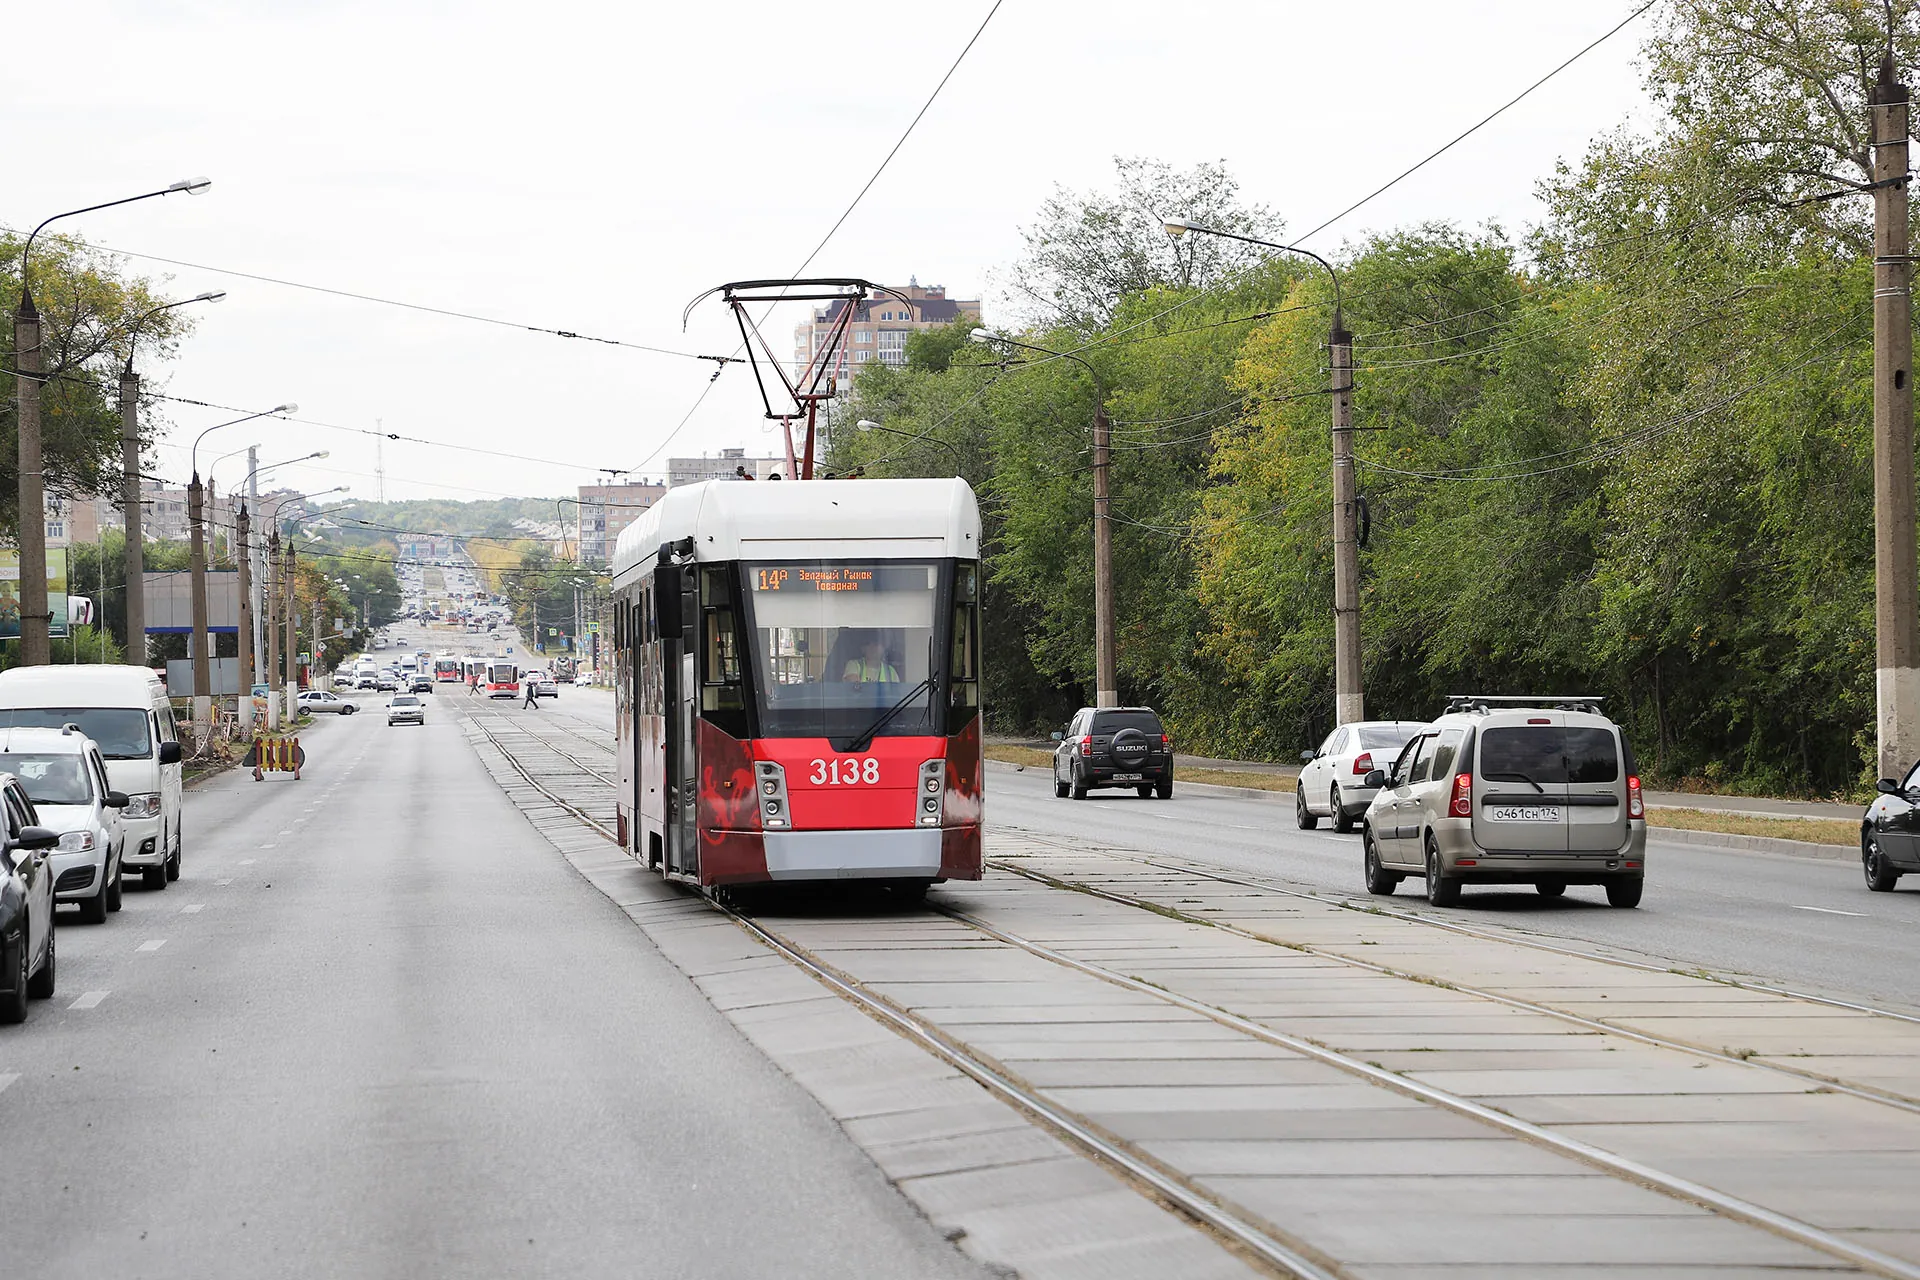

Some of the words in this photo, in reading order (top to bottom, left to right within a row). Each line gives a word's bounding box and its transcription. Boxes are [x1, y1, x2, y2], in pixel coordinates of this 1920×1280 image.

[843, 569, 873, 581] Рынок
[815, 580, 858, 592] Товарная
[809, 758, 880, 785] 3138
[1540, 808, 1558, 817] 174
